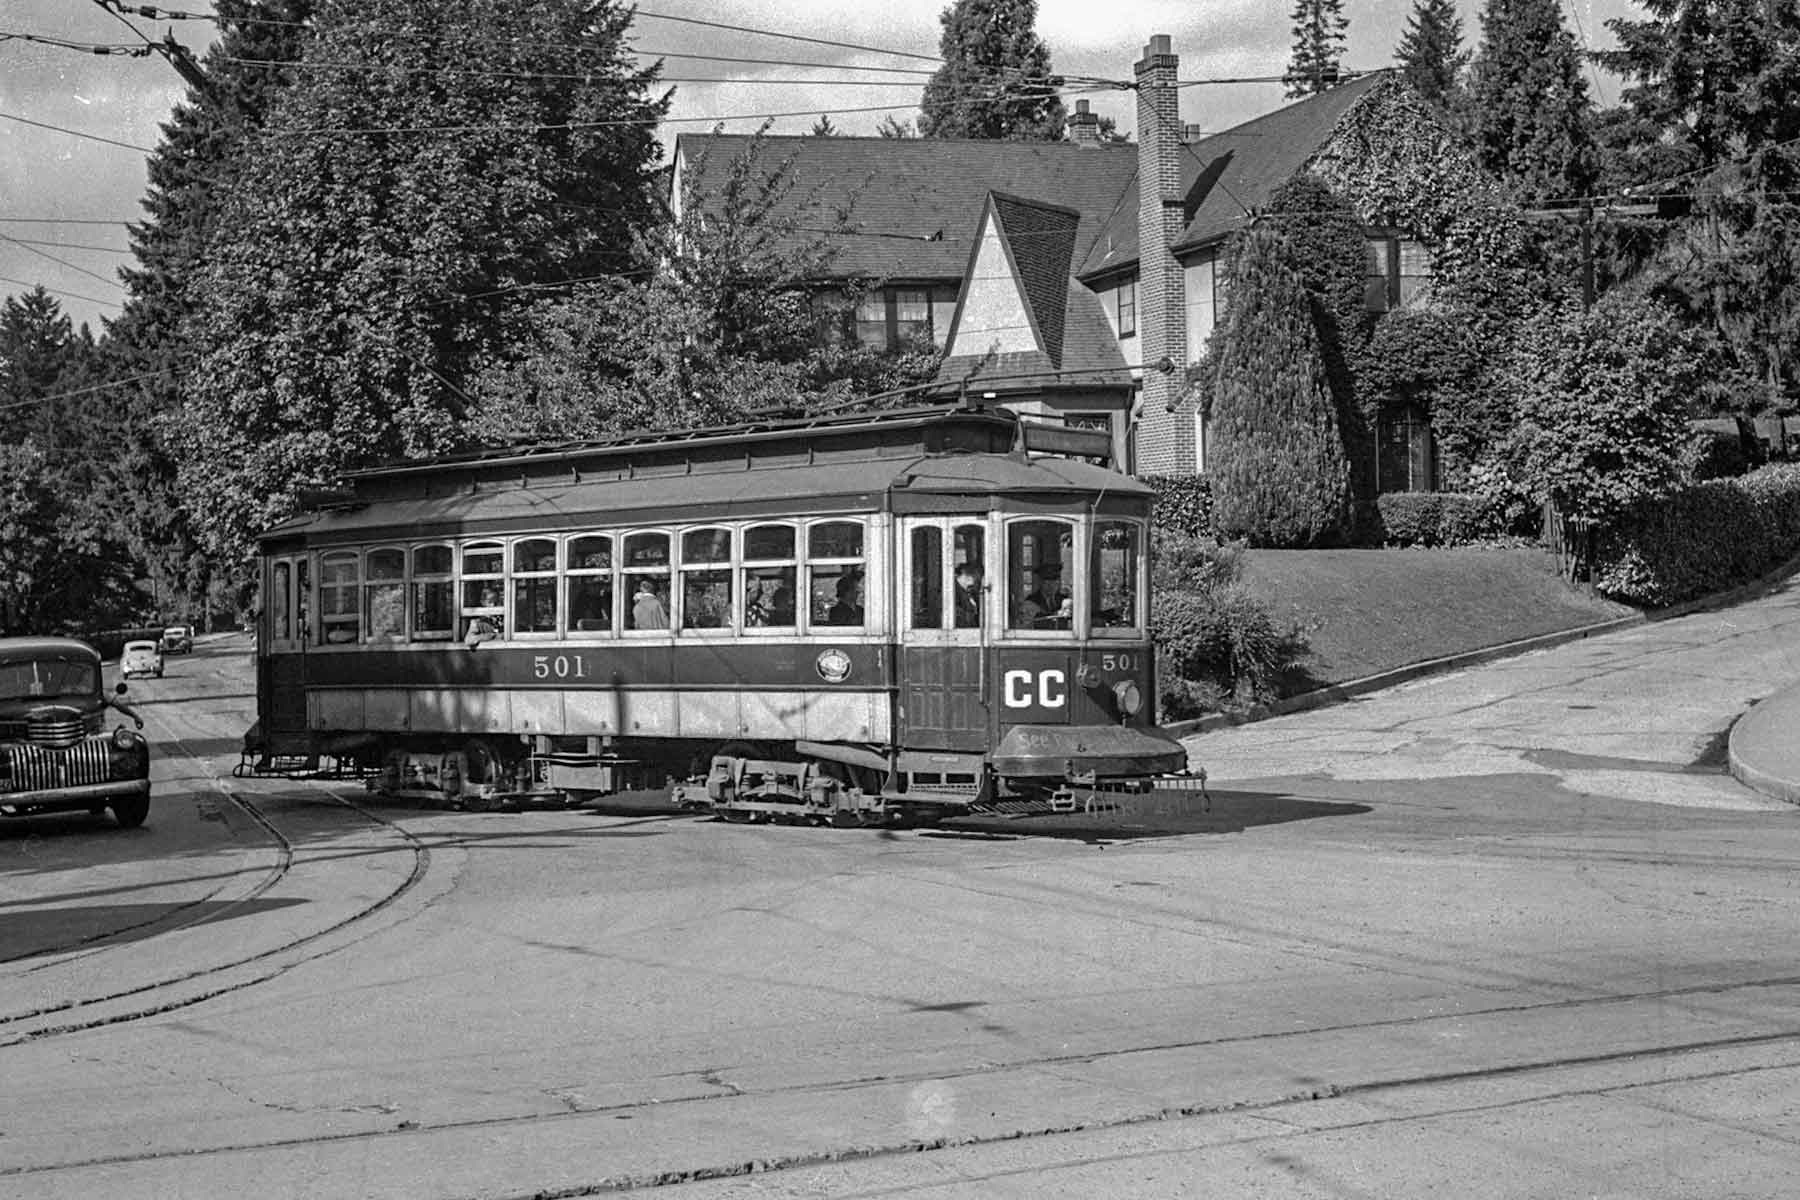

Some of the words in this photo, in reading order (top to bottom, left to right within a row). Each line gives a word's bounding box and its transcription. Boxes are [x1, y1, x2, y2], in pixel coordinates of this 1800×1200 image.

[534, 655, 586, 678] 501
[1102, 654, 1139, 671] 501
[1004, 669, 1065, 708] CC
